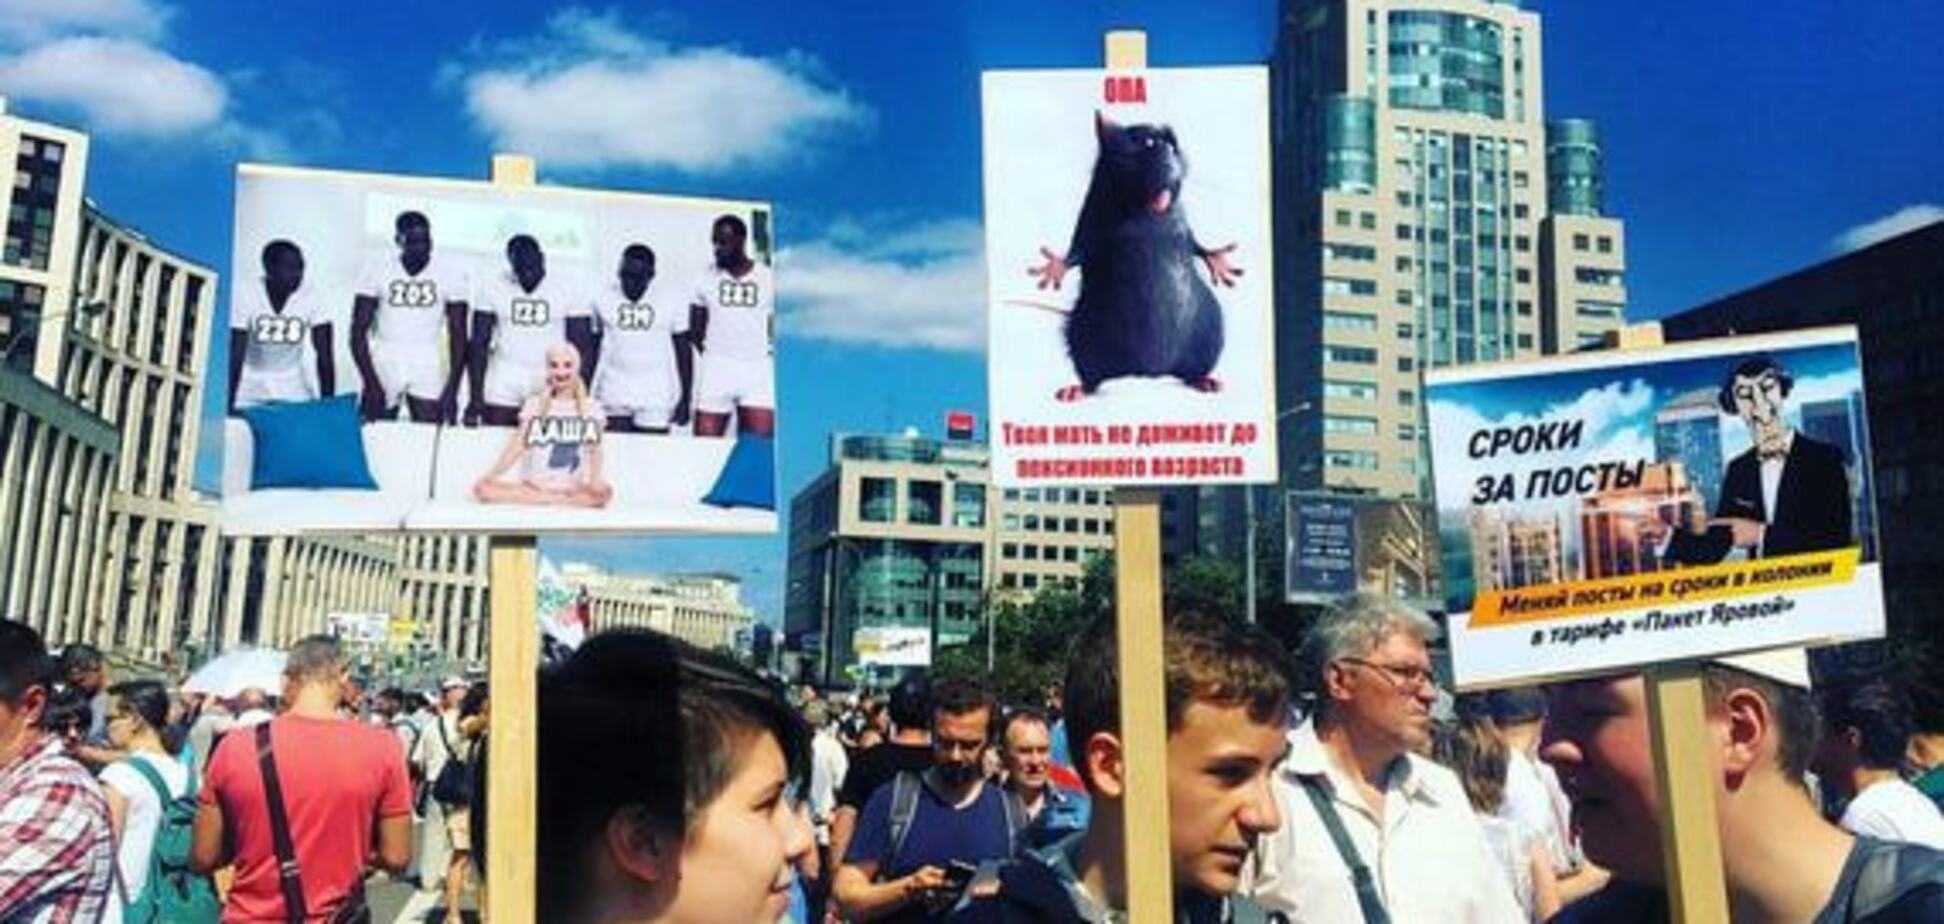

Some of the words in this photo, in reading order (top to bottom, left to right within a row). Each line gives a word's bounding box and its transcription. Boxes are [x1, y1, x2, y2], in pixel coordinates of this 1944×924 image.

[1105, 76, 1146, 103] ОПА
[389, 279, 437, 307] 205
[512, 299, 548, 326] 128
[256, 314, 306, 344] 228
[525, 416, 601, 448] ДАША
[1002, 422, 1048, 445] Твоя
[1054, 425, 1102, 444] мать
[1108, 425, 1132, 444] не
[1136, 423, 1225, 446] доживет
[1231, 421, 1256, 446] до
[1468, 419, 1584, 460] СРОКИ
[1016, 456, 1146, 478] пенсионного
[1151, 456, 1243, 479] возраста
[1472, 473, 1515, 505] ЗА
[1525, 458, 1646, 499] ПОСТЫ
[1500, 588, 1569, 616] Меняй
[1572, 585, 1635, 607] посты
[1641, 582, 1665, 597] на
[1670, 574, 1729, 599] сроки
[1732, 571, 1746, 587] в
[1751, 561, 1834, 584] колонии
[1530, 630, 1544, 646] в
[1550, 617, 1626, 645] тарифе
[1632, 609, 1706, 633] «Пакет
[1709, 595, 1796, 627] Яровой»
